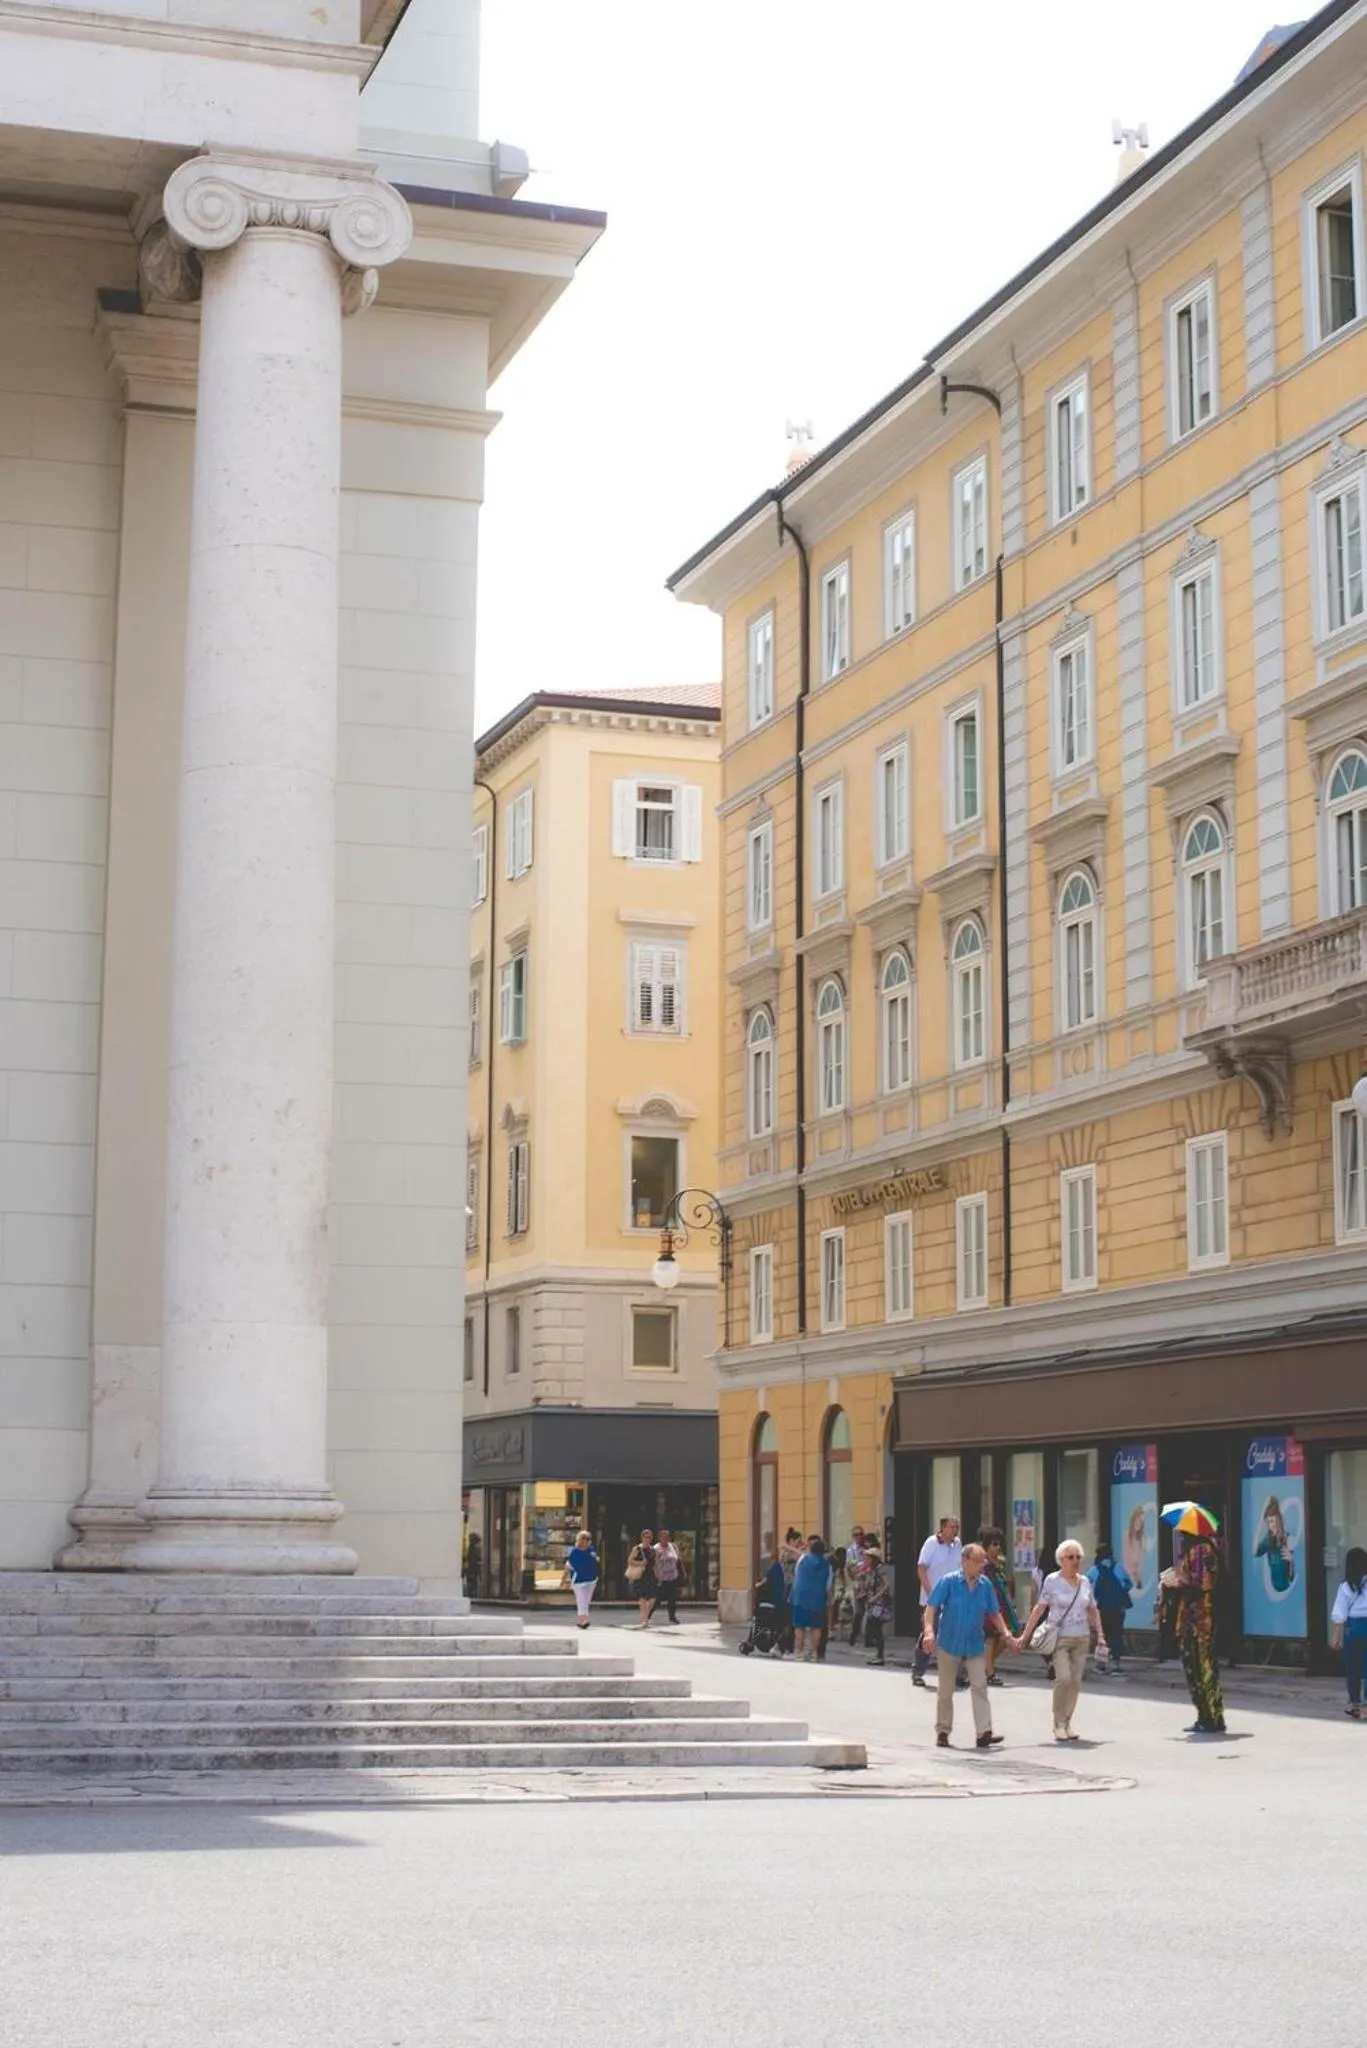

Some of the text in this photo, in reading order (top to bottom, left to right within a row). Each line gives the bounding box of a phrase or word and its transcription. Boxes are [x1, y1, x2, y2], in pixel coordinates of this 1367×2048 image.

[883, 1169, 943, 1198] CENTRALE
[1113, 1451, 1146, 1478] Caddy's
[1247, 1442, 1285, 1471] Caddy's
